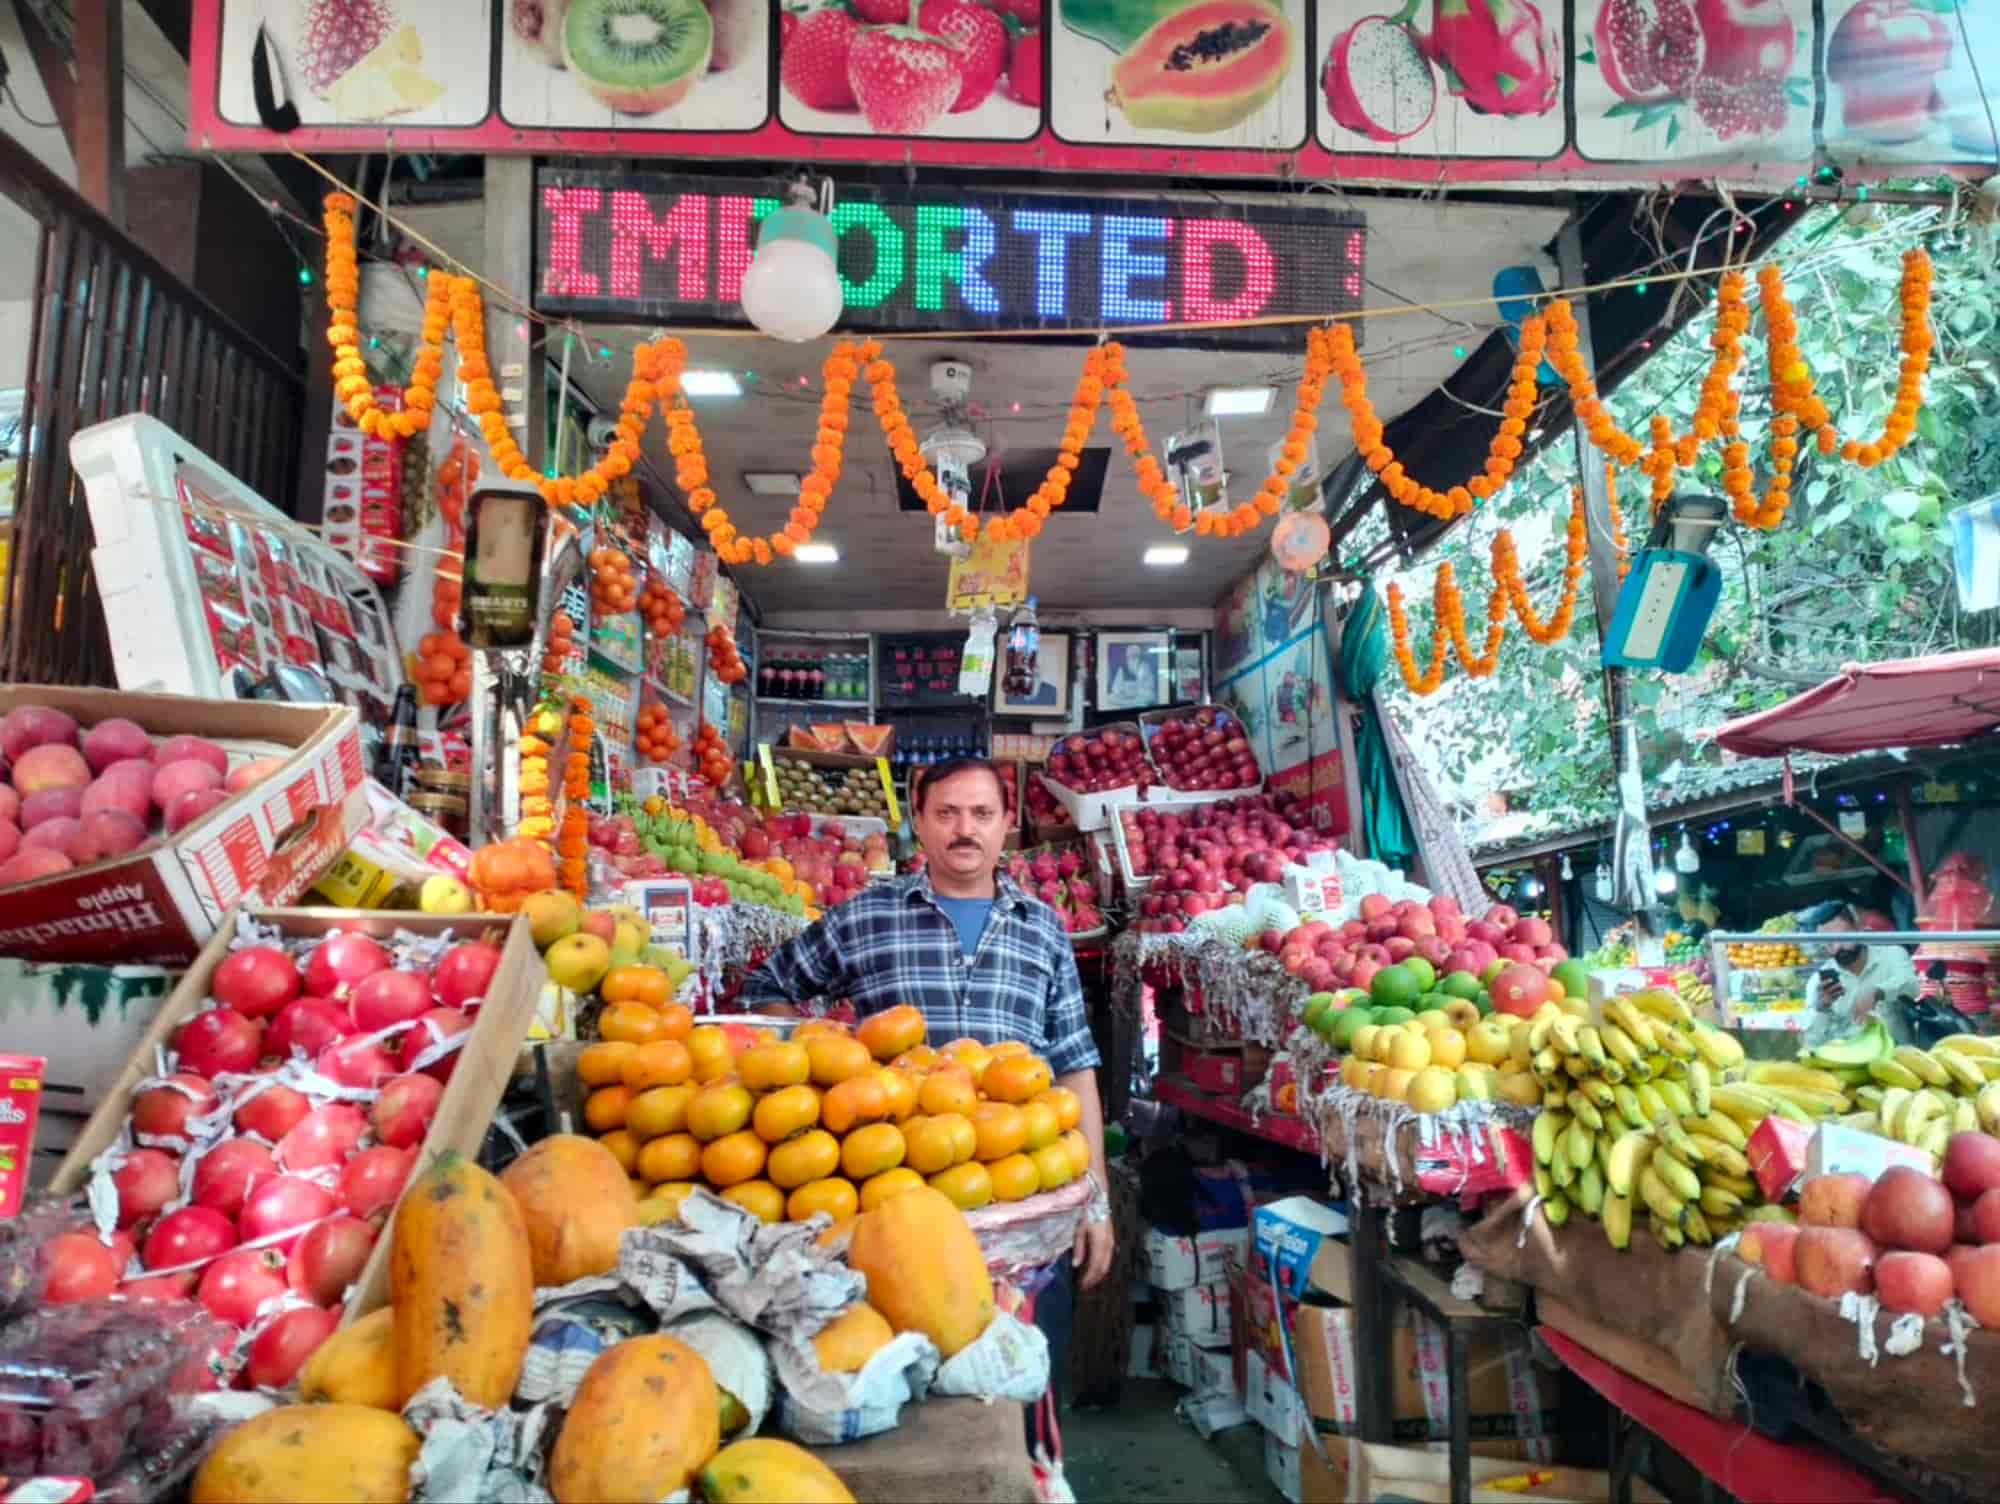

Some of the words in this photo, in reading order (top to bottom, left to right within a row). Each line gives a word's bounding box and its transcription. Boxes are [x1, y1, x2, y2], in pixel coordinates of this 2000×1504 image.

[543, 186, 1275, 322] IMPORTED
[77, 883, 144, 911] Apple
[0, 902, 163, 948] Himacha
